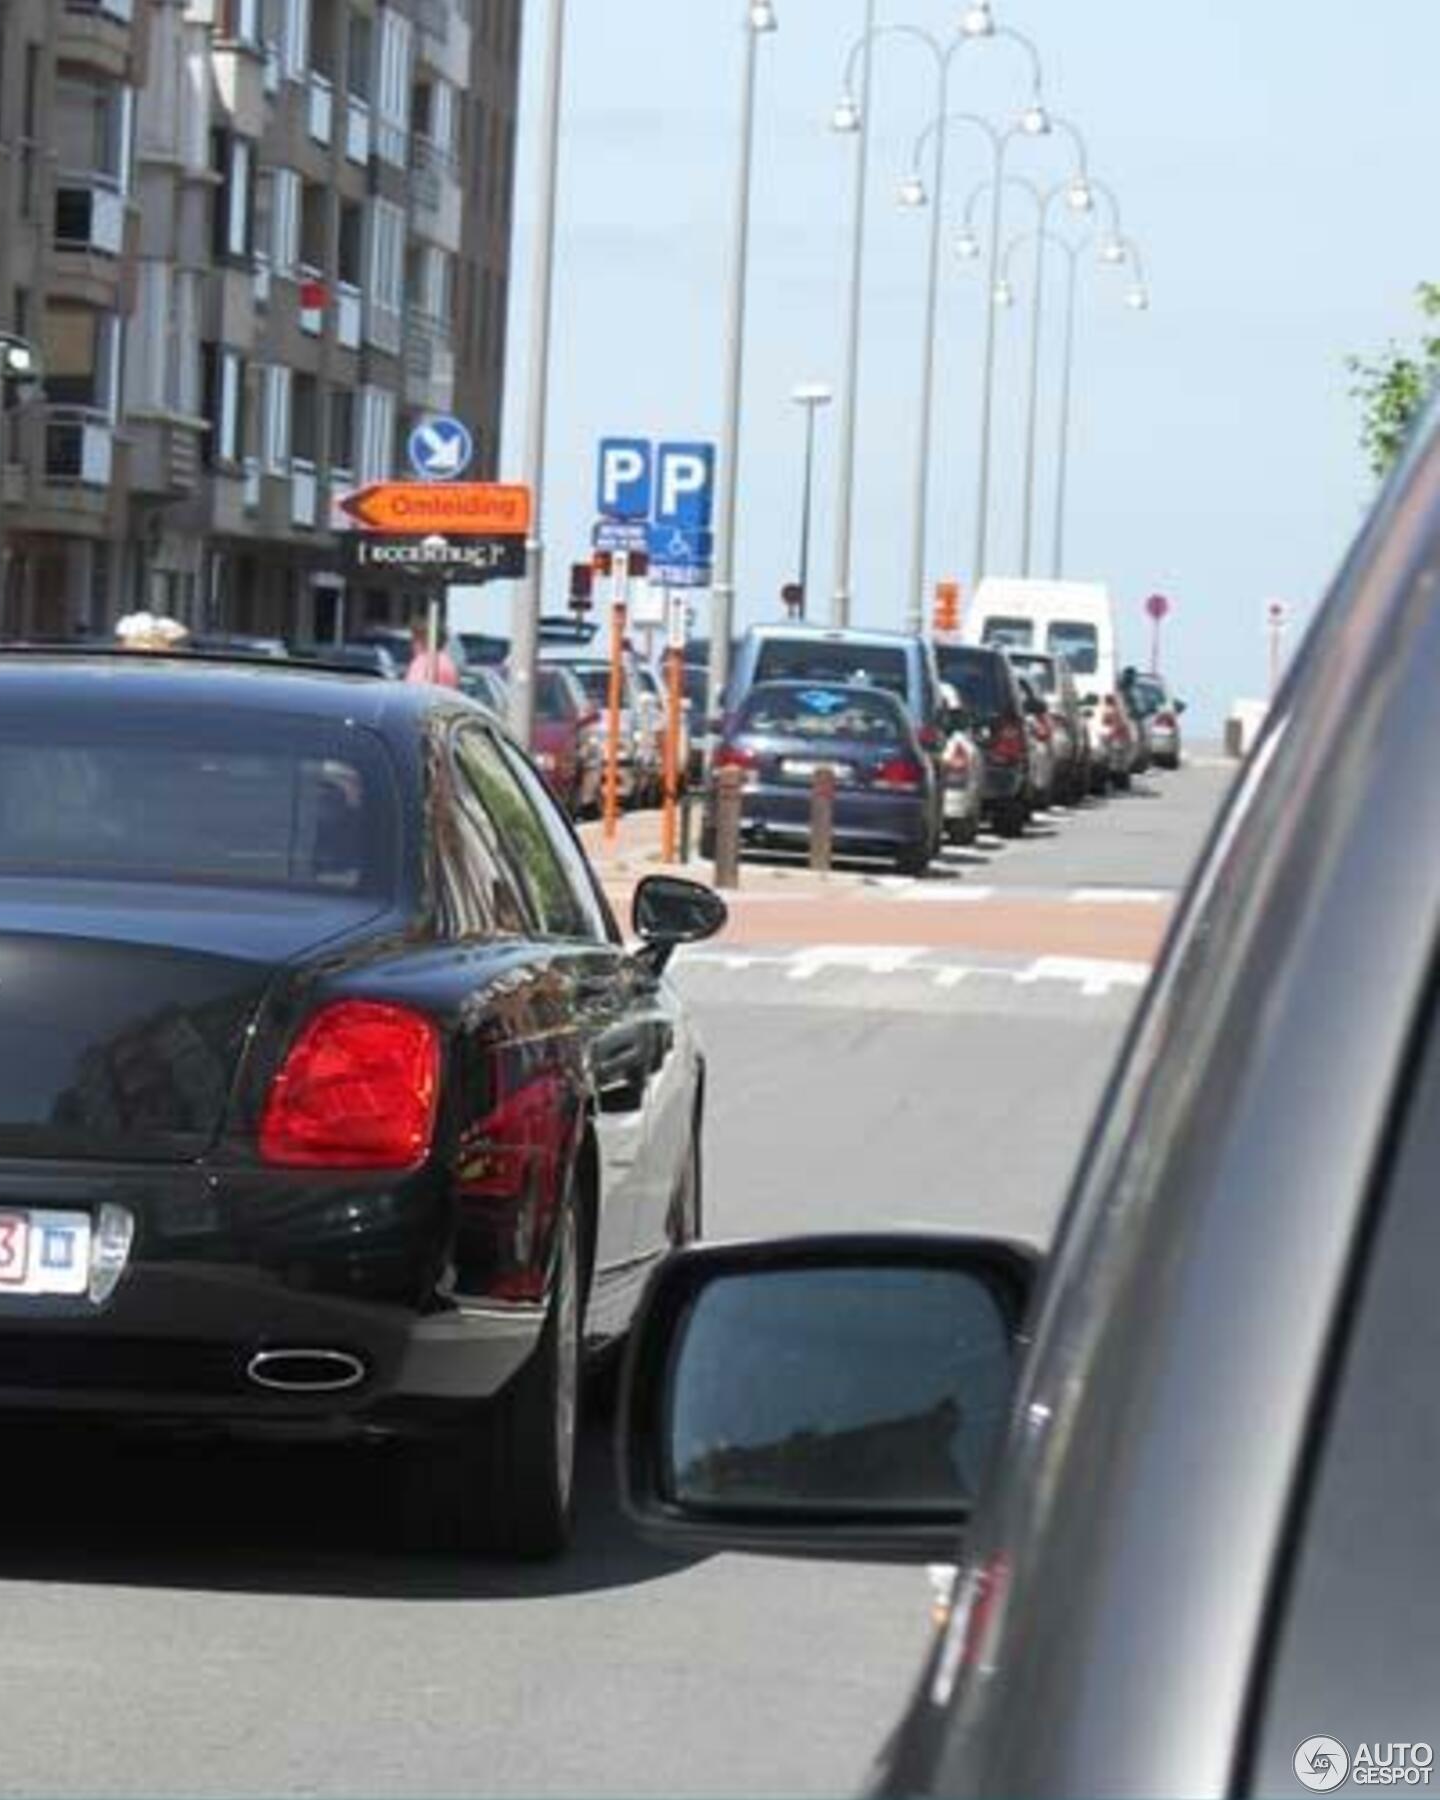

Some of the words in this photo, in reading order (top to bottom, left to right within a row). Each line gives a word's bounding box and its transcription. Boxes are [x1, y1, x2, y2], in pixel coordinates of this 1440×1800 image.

[603, 448, 645, 504] P
[661, 453, 707, 516] P
[391, 493, 517, 520] Omleiding
